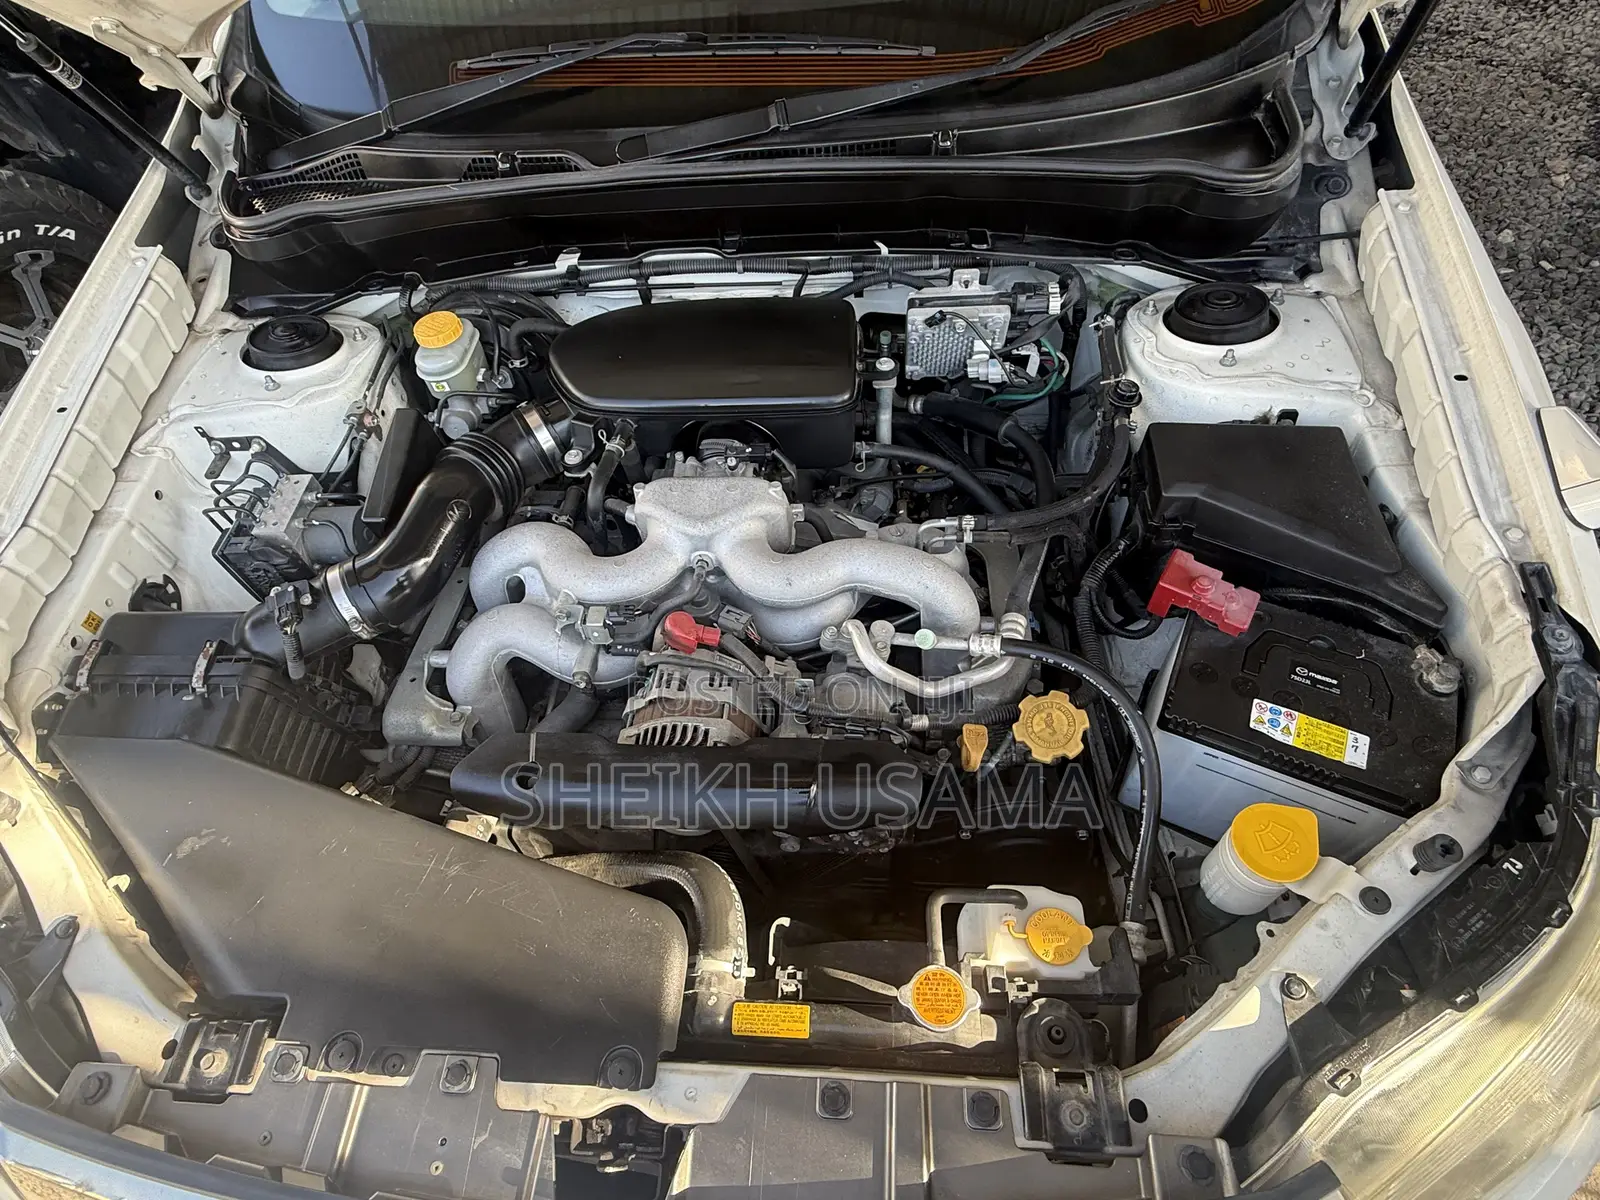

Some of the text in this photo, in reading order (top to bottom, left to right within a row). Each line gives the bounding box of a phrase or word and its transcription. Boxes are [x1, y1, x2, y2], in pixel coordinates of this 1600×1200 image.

[34, 224, 76, 241] T/A
[1309, 672, 1339, 685] mazda
[1030, 910, 1076, 929] COOLANT
